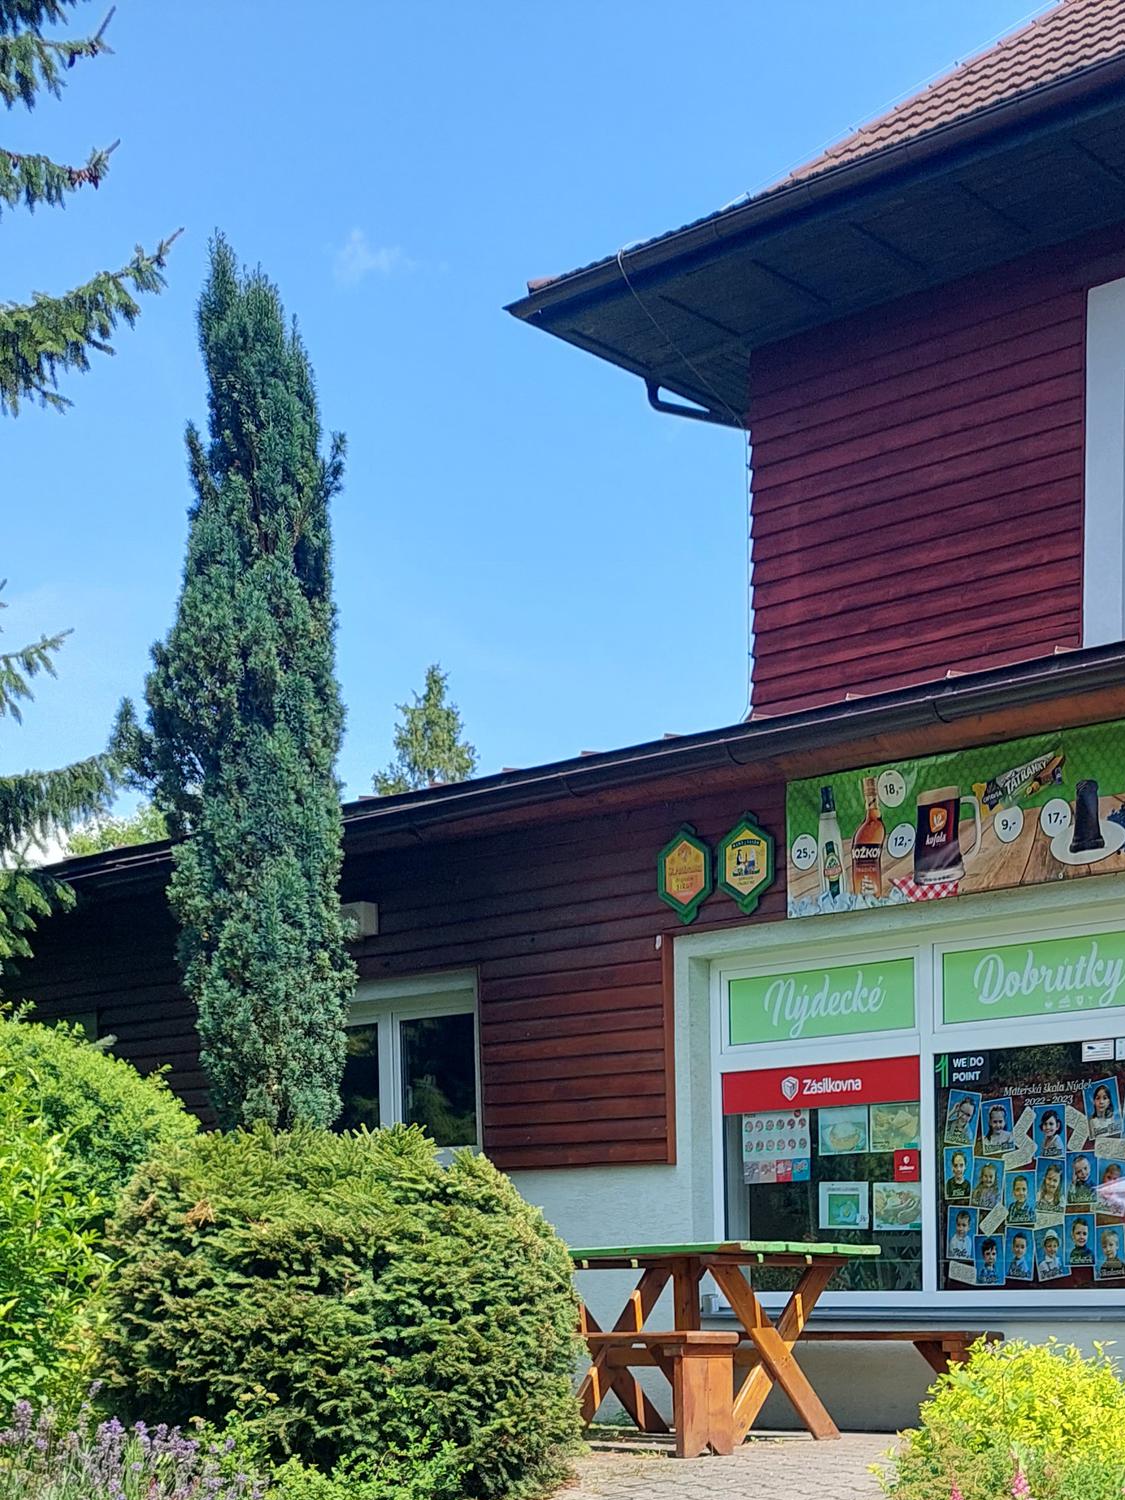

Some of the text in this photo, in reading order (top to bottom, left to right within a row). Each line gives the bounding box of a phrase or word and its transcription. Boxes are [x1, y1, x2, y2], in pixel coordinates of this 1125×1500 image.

[883, 783, 904, 797] 18,-
[1001, 818, 1016, 831] 9,-
[1047, 812, 1067, 825] 17,-
[893, 836, 913, 848] 12,-
[795, 848, 816, 861] 25,-
[764, 970, 887, 1039] Nýdecké
[952, 1070, 982, 1083] POINT
[802, 1077, 862, 1095] Zásilkovna
[1003, 1078, 1093, 1097] Mateřská škola Nýdek
